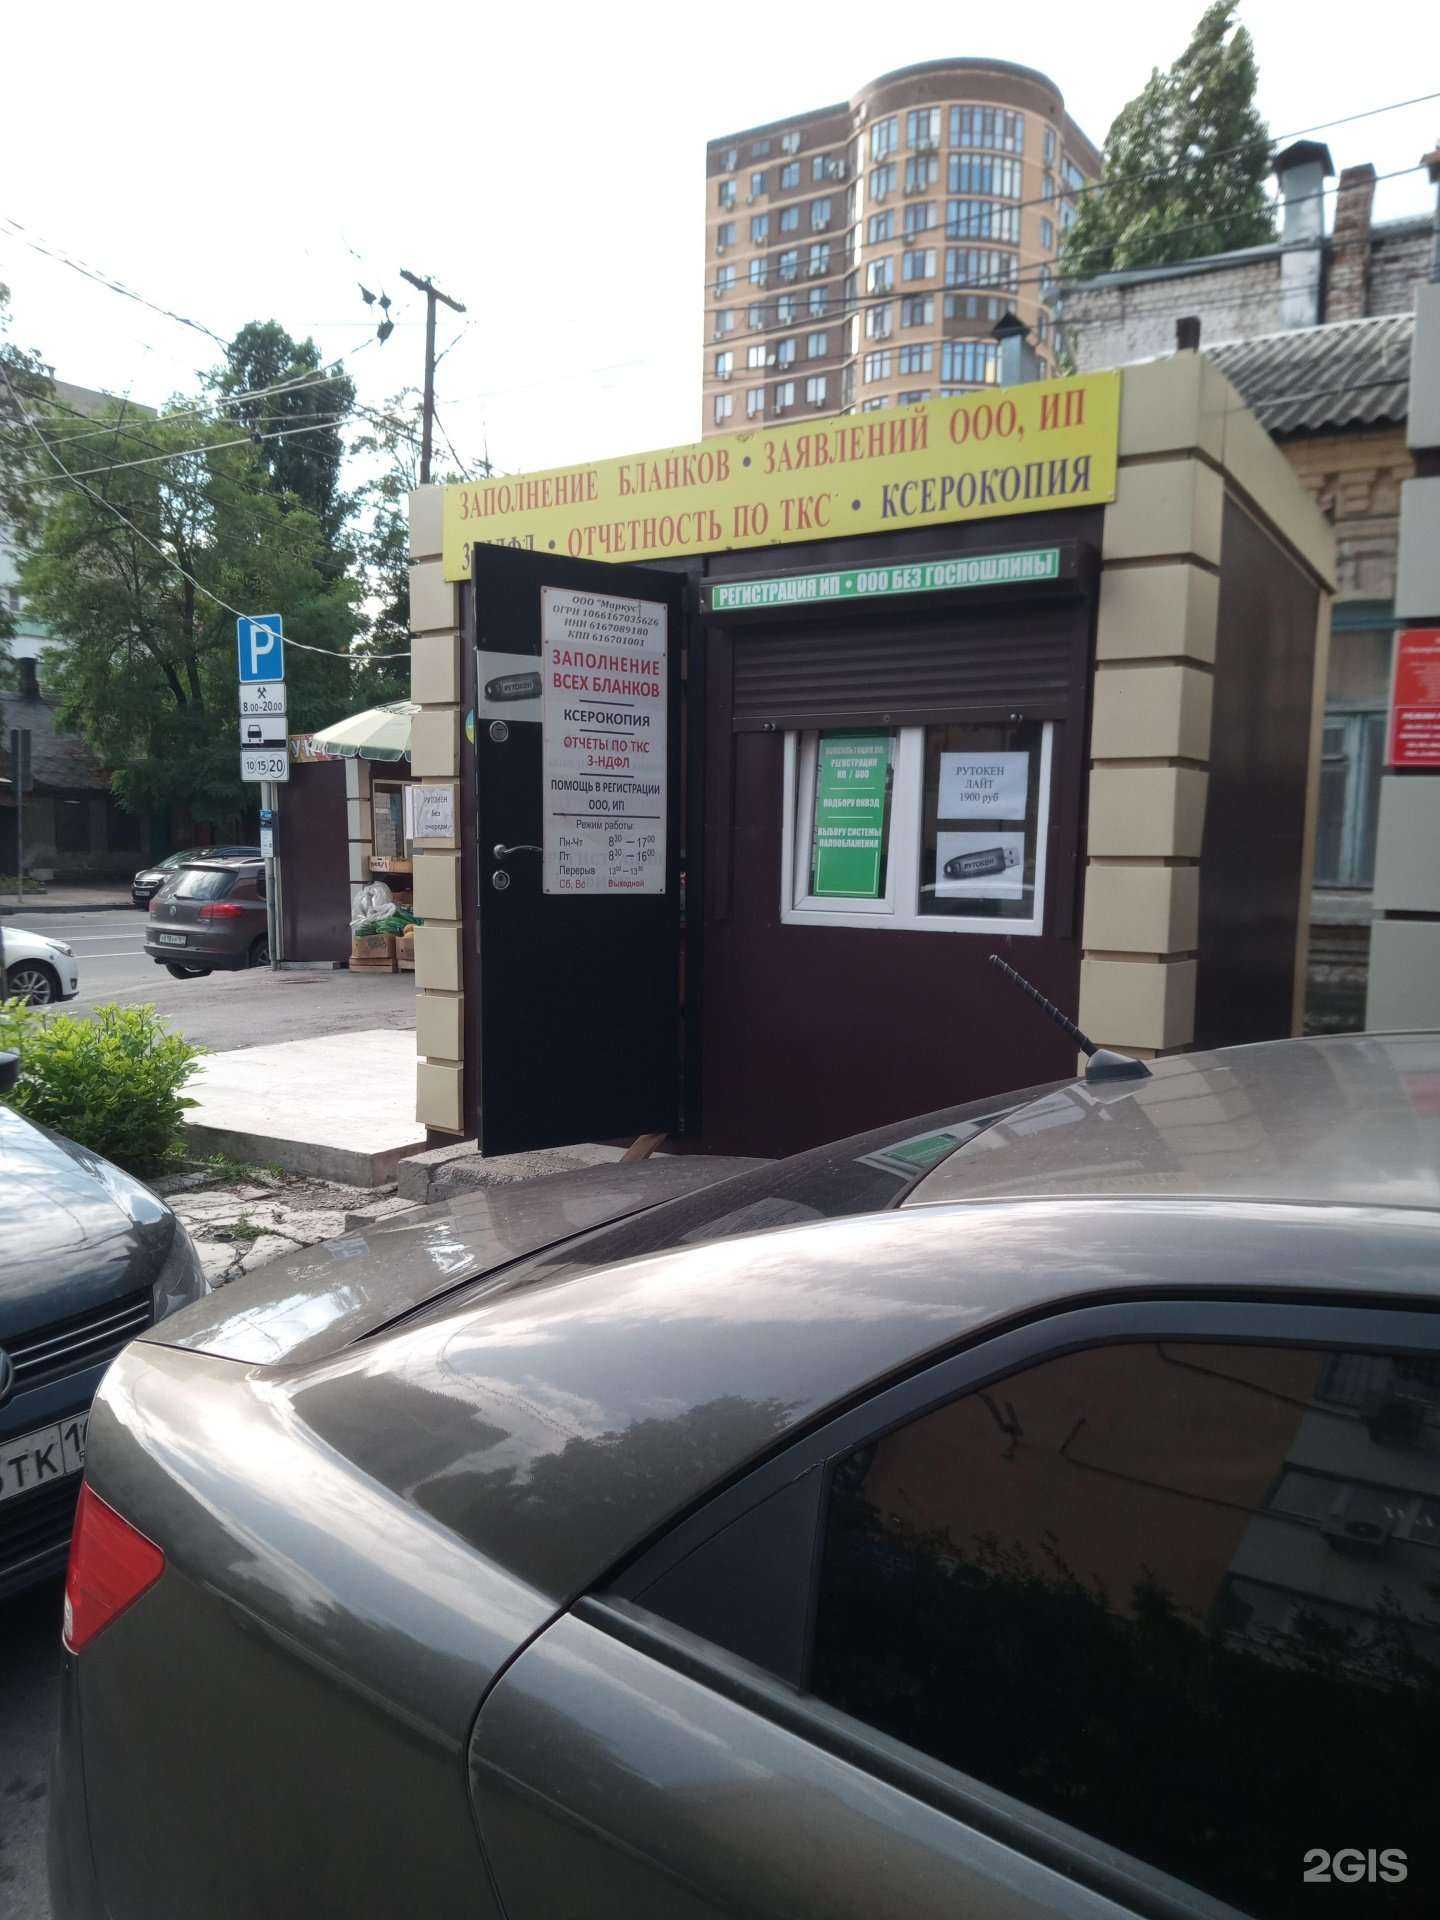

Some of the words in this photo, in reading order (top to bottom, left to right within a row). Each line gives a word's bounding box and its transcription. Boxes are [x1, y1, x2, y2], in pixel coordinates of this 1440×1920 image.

[459, 470, 598, 520] ЗАПОЛНЕНИЕ
[618, 449, 730, 496] БЛАНКОВ
[764, 407, 928, 474] ЗАЯВЛЕНИЙ
[950, 400, 1025, 445] ООО,
[1040, 389, 1087, 431] ИП
[568, 509, 722, 558] ОТЧЕТНОСТЬ
[734, 502, 769, 538] ПО
[781, 493, 832, 531] ТКС
[882, 455, 1092, 519] КСЕРОКОПИЯ
[719, 578, 817, 606] РЕГИСТРАЦИЯ
[820, 576, 840, 596] ИП
[857, 571, 888, 593] ООО
[892, 568, 922, 590] БЕЗ
[926, 554, 1052, 586] ГОСПОШЛИНЫ
[572, 596, 594, 606] ООО
[552, 605, 579, 615] ОГРН
[564, 618, 587, 628] ИНН
[568, 630, 590, 640] КПП
[250, 624, 274, 674] P
[552, 649, 660, 676] ЗАПОЛНЕНИЕ
[553, 672, 588, 691] ВСЕХ
[593, 677, 660, 698] БЛАНКОВ
[564, 709, 650, 727] КСЕРОКОПИЯ
[563, 736, 608, 751] ОТЧЕТЫ
[611, 739, 628, 752] ПО
[631, 741, 650, 753] ТКС
[246, 761, 255, 770] 10
[257, 761, 266, 770] 15
[269, 760, 283, 772] 20
[587, 755, 630, 770] 3-НДФЛ
[956, 766, 1005, 776] РУТОКЕН
[551, 779, 593, 794] ПОМОЩЬ
[596, 782, 600, 792] В
[603, 782, 660, 797] РЕГИСТРАЦИИ
[965, 778, 995, 789] ЛАЙТ
[824, 798, 855, 808] ПОДБОРУ
[960, 792, 980, 802] 1900
[982, 792, 999, 804] руб
[588, 800, 611, 812] ООО,
[612, 801, 625, 811] ИП
[576, 820, 602, 830] Режим
[604, 820, 633, 831] работы
[559, 837, 583, 848] Пн-Чт
[559, 852, 570, 861] Пт
[559, 865, 596, 878] Перерыв
[608, 880, 645, 889] Выходной
